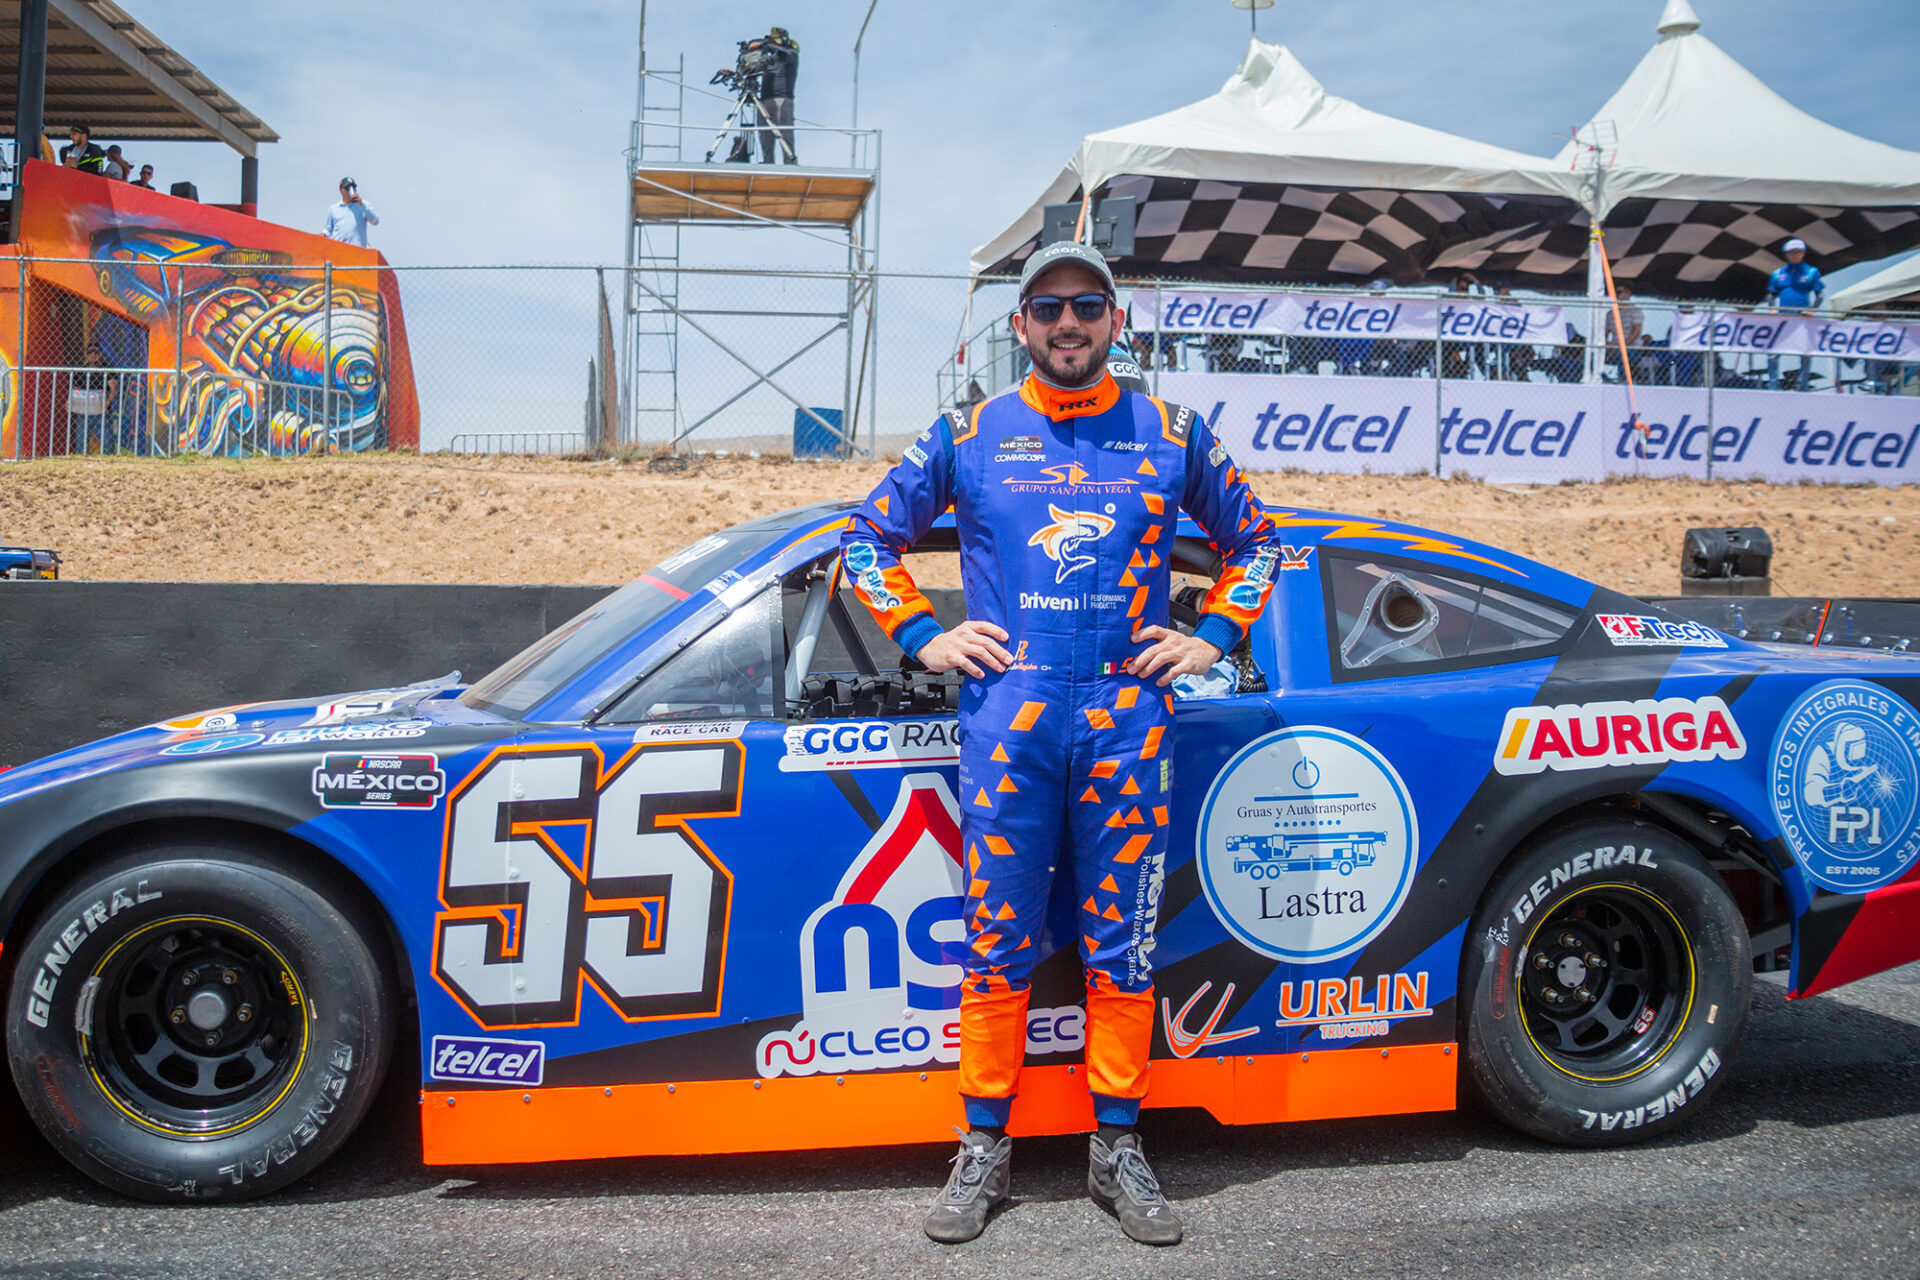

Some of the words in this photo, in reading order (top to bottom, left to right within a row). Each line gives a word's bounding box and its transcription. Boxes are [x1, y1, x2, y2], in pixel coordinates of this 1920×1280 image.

[1163, 297, 1269, 329] telcel
[1303, 300, 1402, 333] telcel
[1441, 305, 1530, 339] telcel
[1699, 318, 1788, 349] telcel
[1817, 324, 1908, 355] telcel
[950, 408, 968, 430] RX
[1059, 396, 1098, 411] HRX
[1252, 402, 1412, 453] telcel
[1440, 407, 1587, 457] telcel
[1615, 412, 1762, 462] telcel
[995, 453, 1046, 463] COMMSCOPE
[1114, 440, 1148, 452] telcel
[1783, 419, 1920, 468] telcel
[1011, 484, 1047, 493] GRUPO
[1049, 484, 1101, 496] SANTANA
[1105, 484, 1132, 494] VEGA
[1019, 591, 1079, 611] Driven
[1090, 601, 1117, 609] PRODUCTS
[1792, 692, 1889, 737] INTEGRALES
[1894, 712, 1905, 727] E
[651, 728, 692, 736] RACE
[698, 726, 730, 734] CAR
[803, 726, 889, 754] GGG
[1529, 710, 1741, 761] AURIGA
[318, 769, 440, 791] MÉXICO
[367, 759, 402, 770] NASCAR
[366, 791, 392, 801] SERIES
[1237, 807, 1273, 818] Gruas
[1276, 809, 1283, 819] y
[1286, 802, 1377, 816] Autotransportes
[1778, 740, 1813, 862] PROYECTOS
[1829, 806, 1881, 844] FPI
[438, 744, 733, 1015] 55
[1512, 844, 1658, 925] GENERAL
[1826, 866, 1849, 875] EST
[1850, 866, 1880, 875] 2005
[1258, 886, 1368, 920] Lastra
[27, 879, 163, 1029] GENERAL
[1279, 972, 1428, 1019] URLIN
[1320, 1021, 1390, 1040] TRUCKING
[1634, 1006, 1656, 1034] 55
[437, 1044, 538, 1079] telcel
[1578, 1048, 1721, 1131] GENERAL
[218, 1039, 353, 1185] GENERAL
